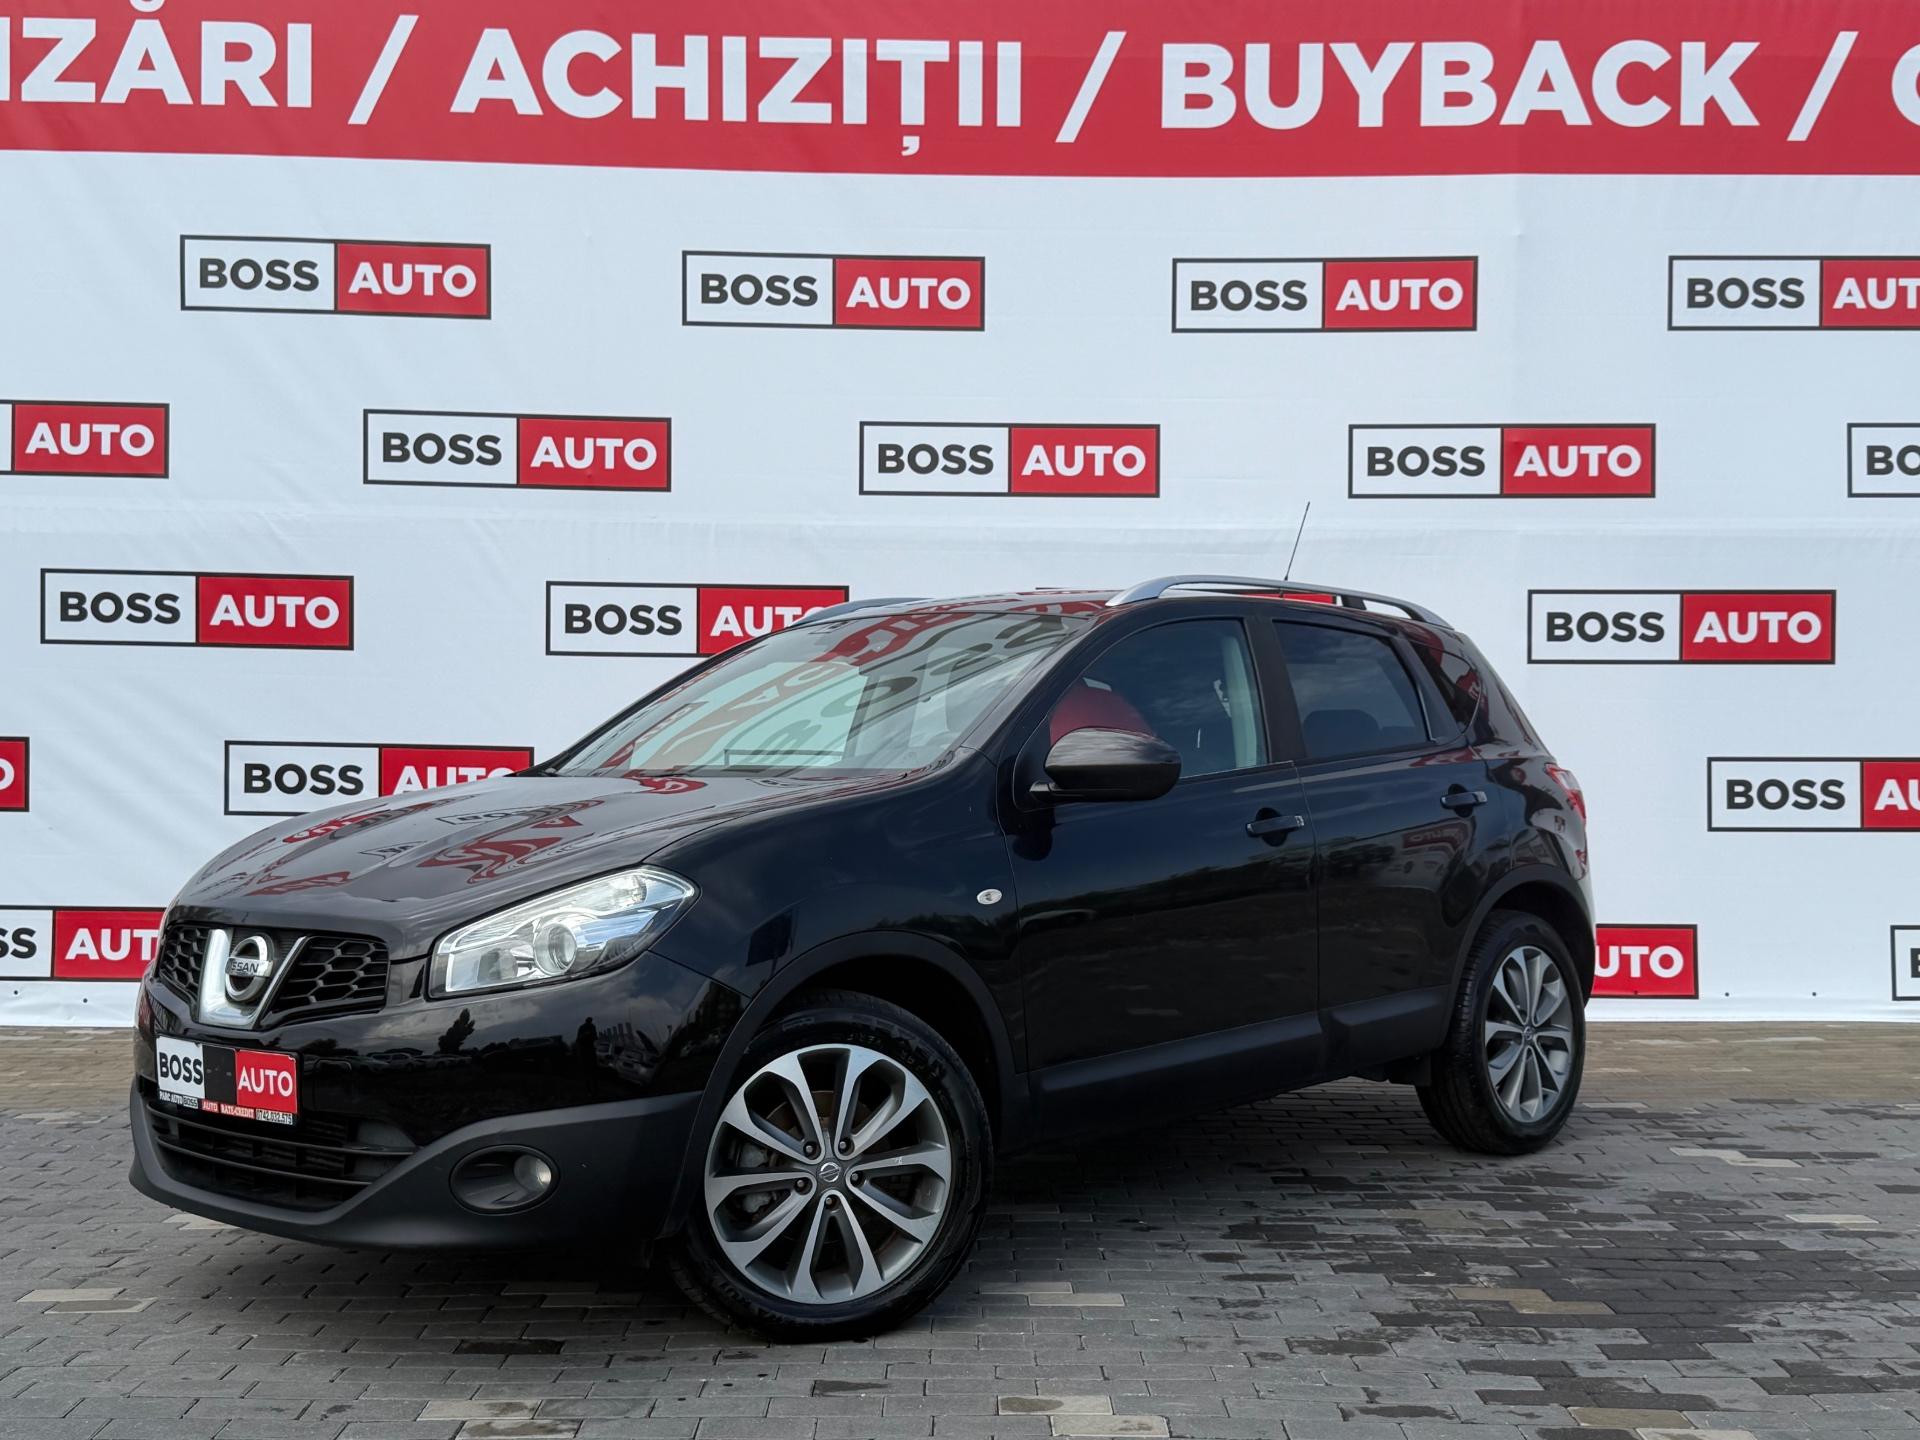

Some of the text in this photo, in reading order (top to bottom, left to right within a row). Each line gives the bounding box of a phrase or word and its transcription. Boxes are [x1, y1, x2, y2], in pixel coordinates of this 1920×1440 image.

[348, 15, 419, 124] /
[450, 28, 1021, 155] ACHIZIȚII
[1056, 31, 1126, 142] /
[1162, 40, 1760, 129] BUYBACK
[1787, 31, 1858, 141] /
[200, 258, 476, 297] BOSS AUTO
[702, 274, 970, 309] BOSS AUTO
[1688, 278, 1920, 309] BOSS AUT
[1191, 278, 1463, 311] BOSS AUTO
[26, 423, 154, 456] AUTO
[383, 432, 656, 470] BOSS AUTO
[879, 444, 1145, 476] BOSS AUTO
[1368, 445, 1641, 477] BOSS AUTO
[1867, 445, 1920, 475] BO
[60, 592, 339, 628] BOSS AUTO
[565, 604, 825, 637] BOSS AUT
[1547, 612, 1821, 643] BOSS AUTO
[244, 763, 514, 796] BOSS AUT
[1727, 779, 1845, 810] BOSS
[159, 1052, 294, 1097] BOSS AUTO
